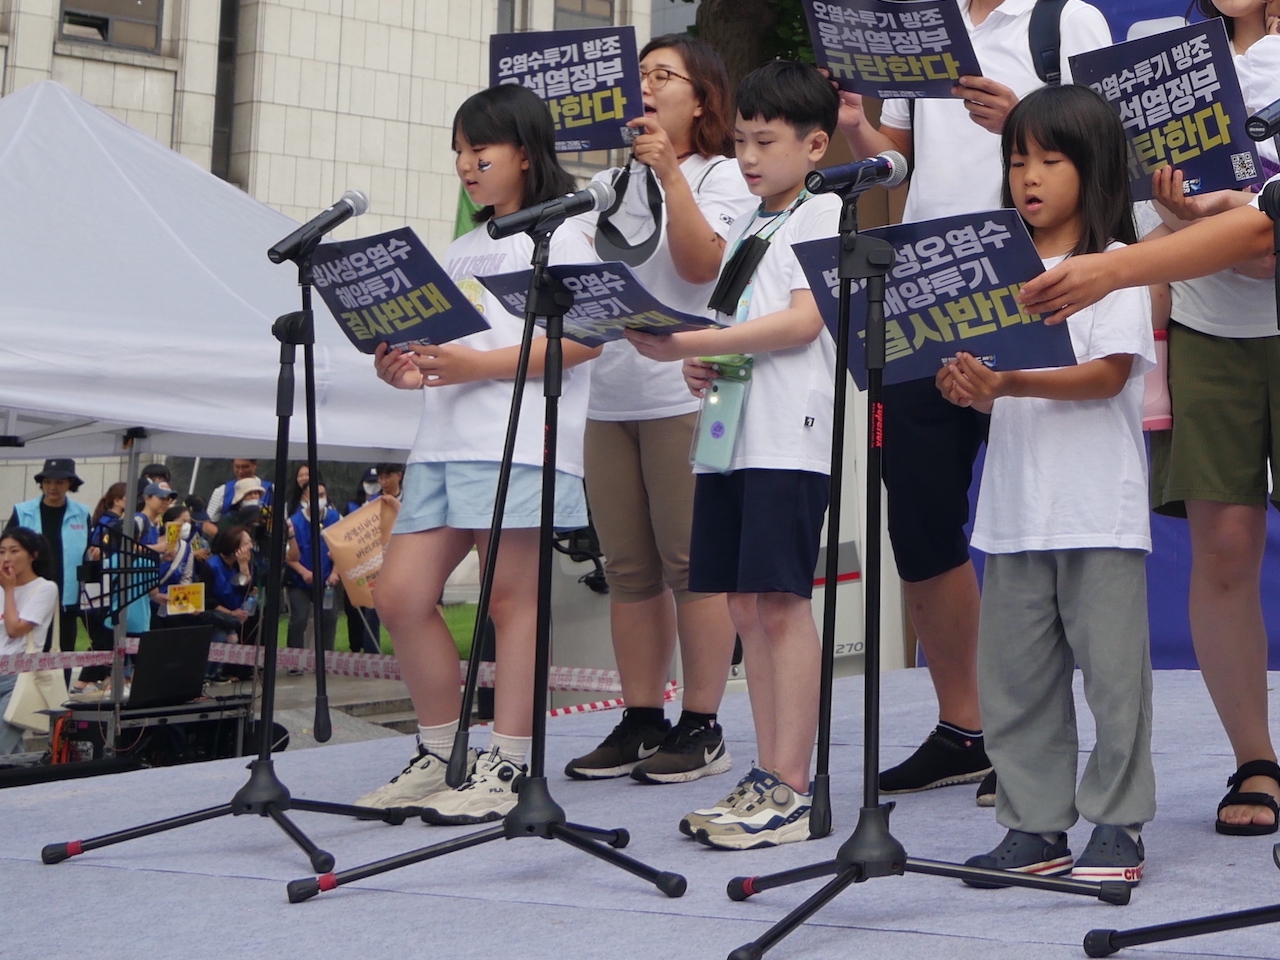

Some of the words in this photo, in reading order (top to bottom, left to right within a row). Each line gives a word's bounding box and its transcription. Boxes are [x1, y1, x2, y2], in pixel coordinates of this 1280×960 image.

[812, 0, 898, 29] 오염수투기
[899, 7, 945, 29] 방조
[498, 43, 579, 77] 오염수투기
[582, 35, 622, 60] 방조
[818, 21, 952, 55] 윤석열정부
[1171, 33, 1213, 71] 방조
[825, 49, 961, 82] 규탄한다
[1119, 62, 1221, 131] 석열정부
[822, 220, 1012, 298] 방성오염수
[335, 267, 413, 309] 해양투기
[502, 270, 627, 313] 방오염수
[340, 282, 453, 340] 결사반대
[563, 296, 634, 324] 양투기
[836, 642, 863, 654] 270
